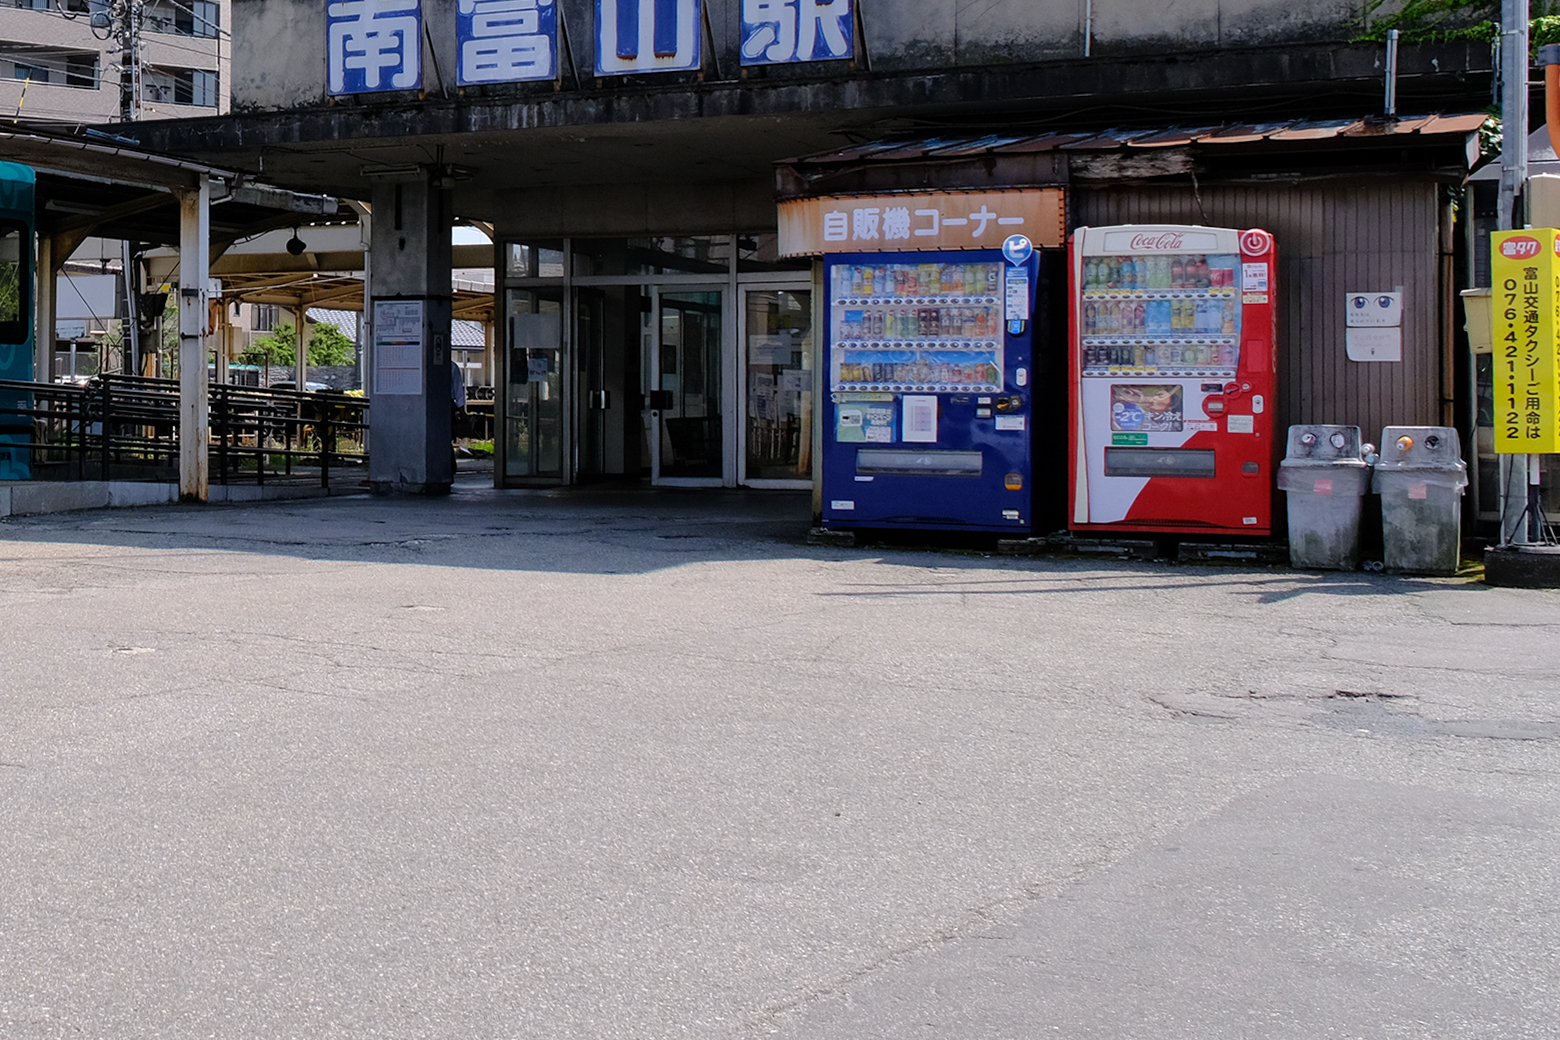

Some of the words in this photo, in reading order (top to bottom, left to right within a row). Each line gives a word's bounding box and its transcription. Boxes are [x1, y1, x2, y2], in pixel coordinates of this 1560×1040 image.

[822, 204, 1025, 242] 自販機コーナー
[1129, 231, 1186, 251] Coca-Cola
[1503, 241, 1538, 256] 富タク
[1523, 266, 1541, 439] 富山交通タクシーご用命は
